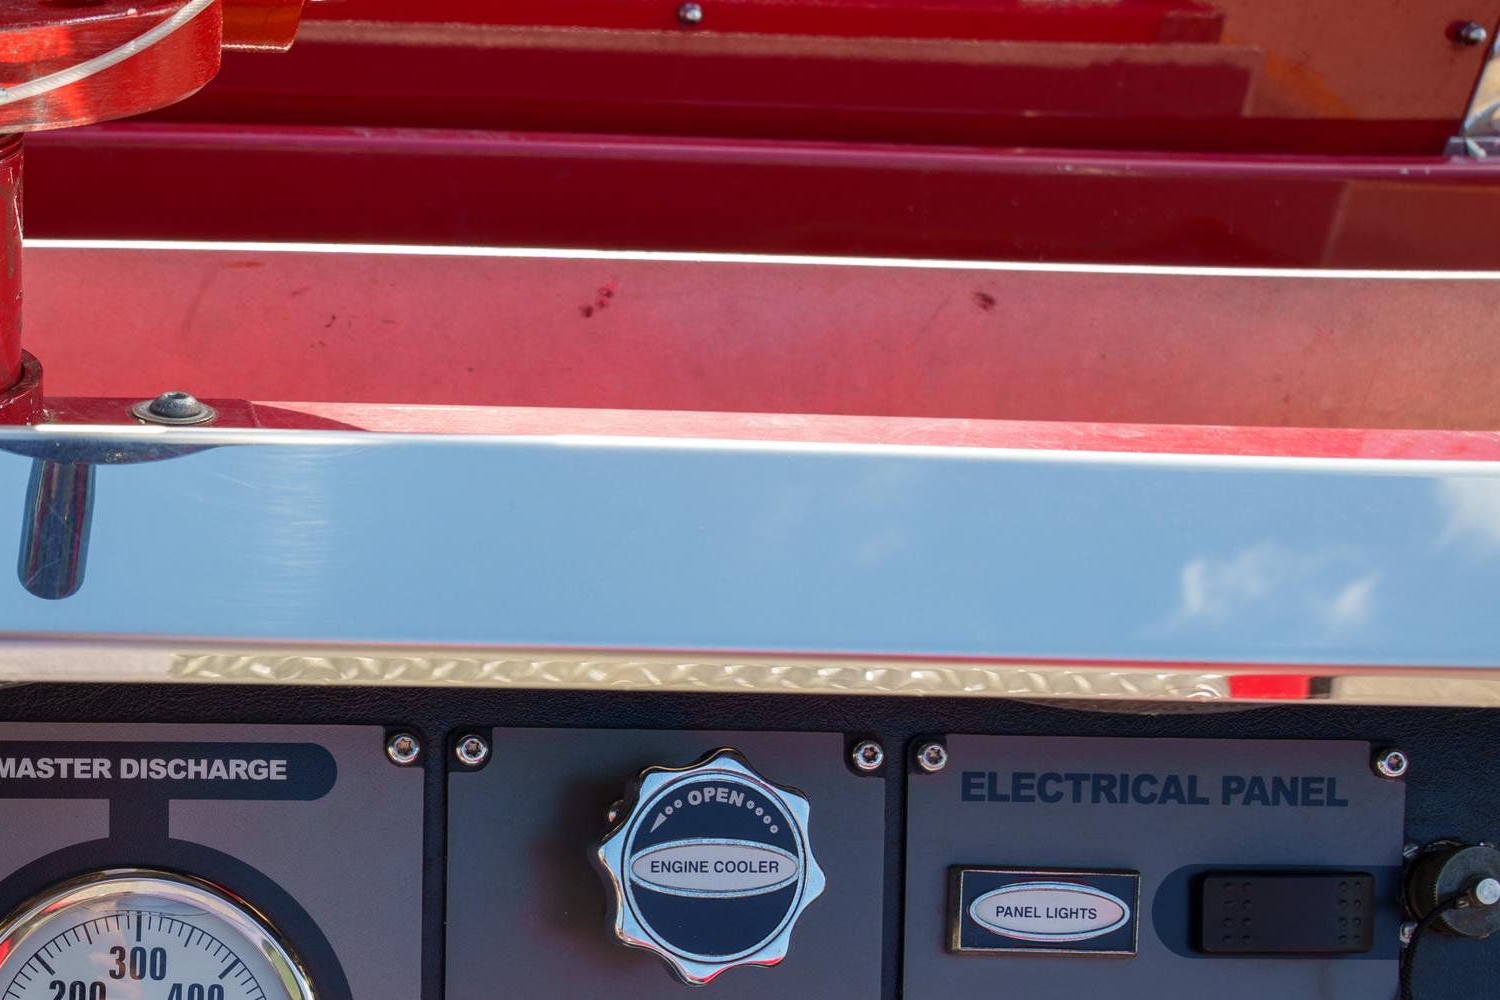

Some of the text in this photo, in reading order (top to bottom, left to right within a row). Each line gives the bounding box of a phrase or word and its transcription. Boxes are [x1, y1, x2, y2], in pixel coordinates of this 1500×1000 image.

[120, 758, 287, 781] DISCHARGE
[687, 786, 745, 807] OPEN
[961, 771, 1348, 807] ELECTRICAL PANEL
[651, 860, 779, 874] ENGINE COOLER
[995, 905, 1097, 920] PANEL LIGHTS
[109, 946, 167, 980] 300
